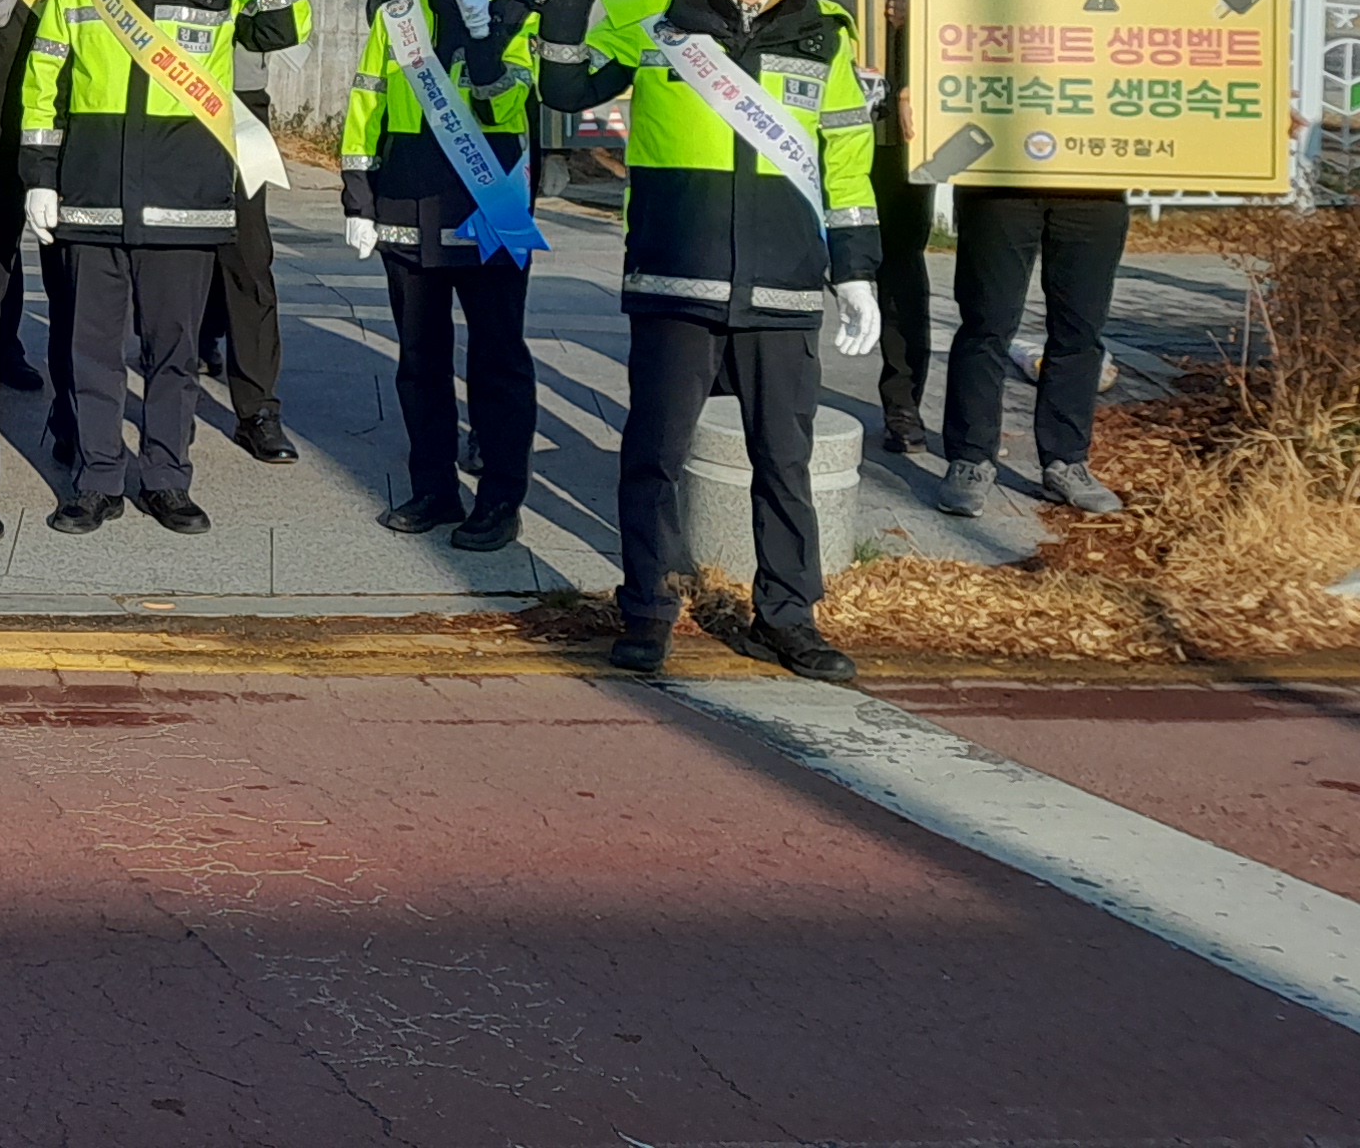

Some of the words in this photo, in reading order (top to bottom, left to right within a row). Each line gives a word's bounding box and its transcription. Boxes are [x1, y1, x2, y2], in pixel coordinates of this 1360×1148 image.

[938, 24, 1095, 63] 안전벨트
[1107, 26, 1263, 67] 생명벨트
[150, 45, 223, 117] 일단멈춤
[937, 75, 1095, 116] 안전속도
[1106, 77, 1263, 119] 생명속도
[780, 135, 804, 162] 위한
[1064, 136, 1175, 158] 하동경찰서
